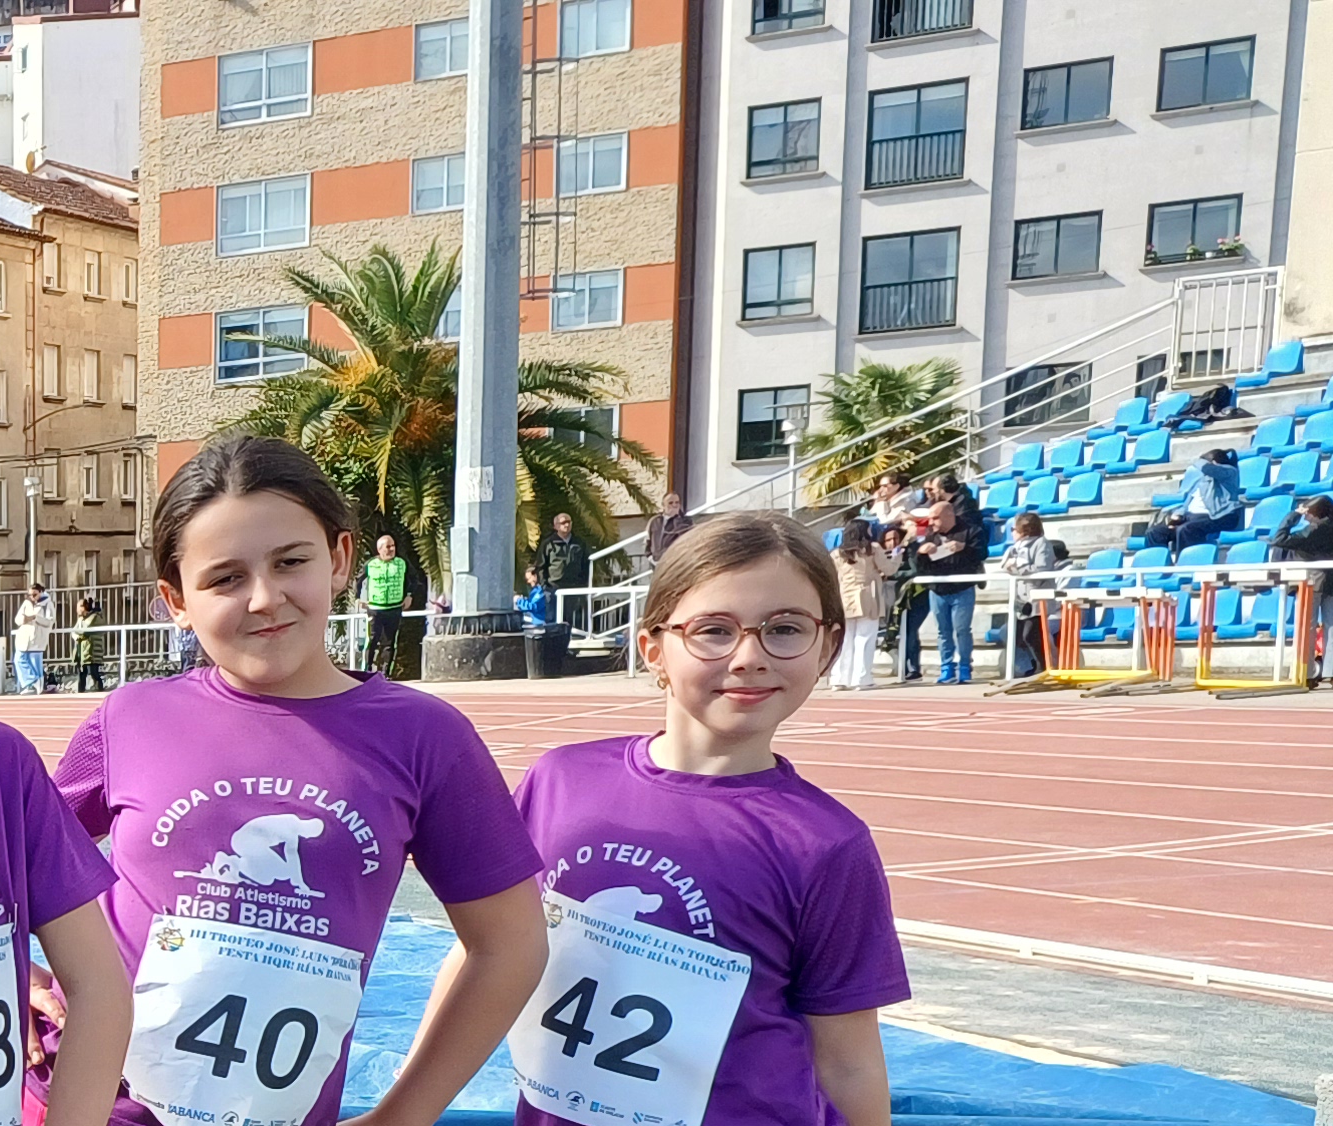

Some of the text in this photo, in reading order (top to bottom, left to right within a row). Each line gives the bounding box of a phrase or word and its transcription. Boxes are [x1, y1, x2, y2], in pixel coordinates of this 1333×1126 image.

[151, 777, 380, 876] COIDA O TEU PLANETA
[197, 882, 311, 910] Club Atletismo
[541, 842, 716, 939] IDA O TEU PLANET
[175, 895, 330, 936] Rías Baixas
[579, 913, 617, 935] TROFEO
[617, 927, 652, 946] JOSÉ
[653, 938, 685, 956] LUIS
[190, 929, 207, 940] III
[210, 932, 265, 950] TROFEO
[266, 941, 300, 957] JOSÉ
[300, 948, 329, 963] LUIS
[218, 946, 259, 963] FESTA
[296, 960, 324, 976] RÍAS
[584, 929, 611, 947] FESTA
[646, 951, 679, 968] RÍAS
[680, 961, 728, 982] BAIXAS
[175, 994, 319, 1090] 40
[541, 976, 673, 1082] 42
[167, 1104, 215, 1123] ABANCA
